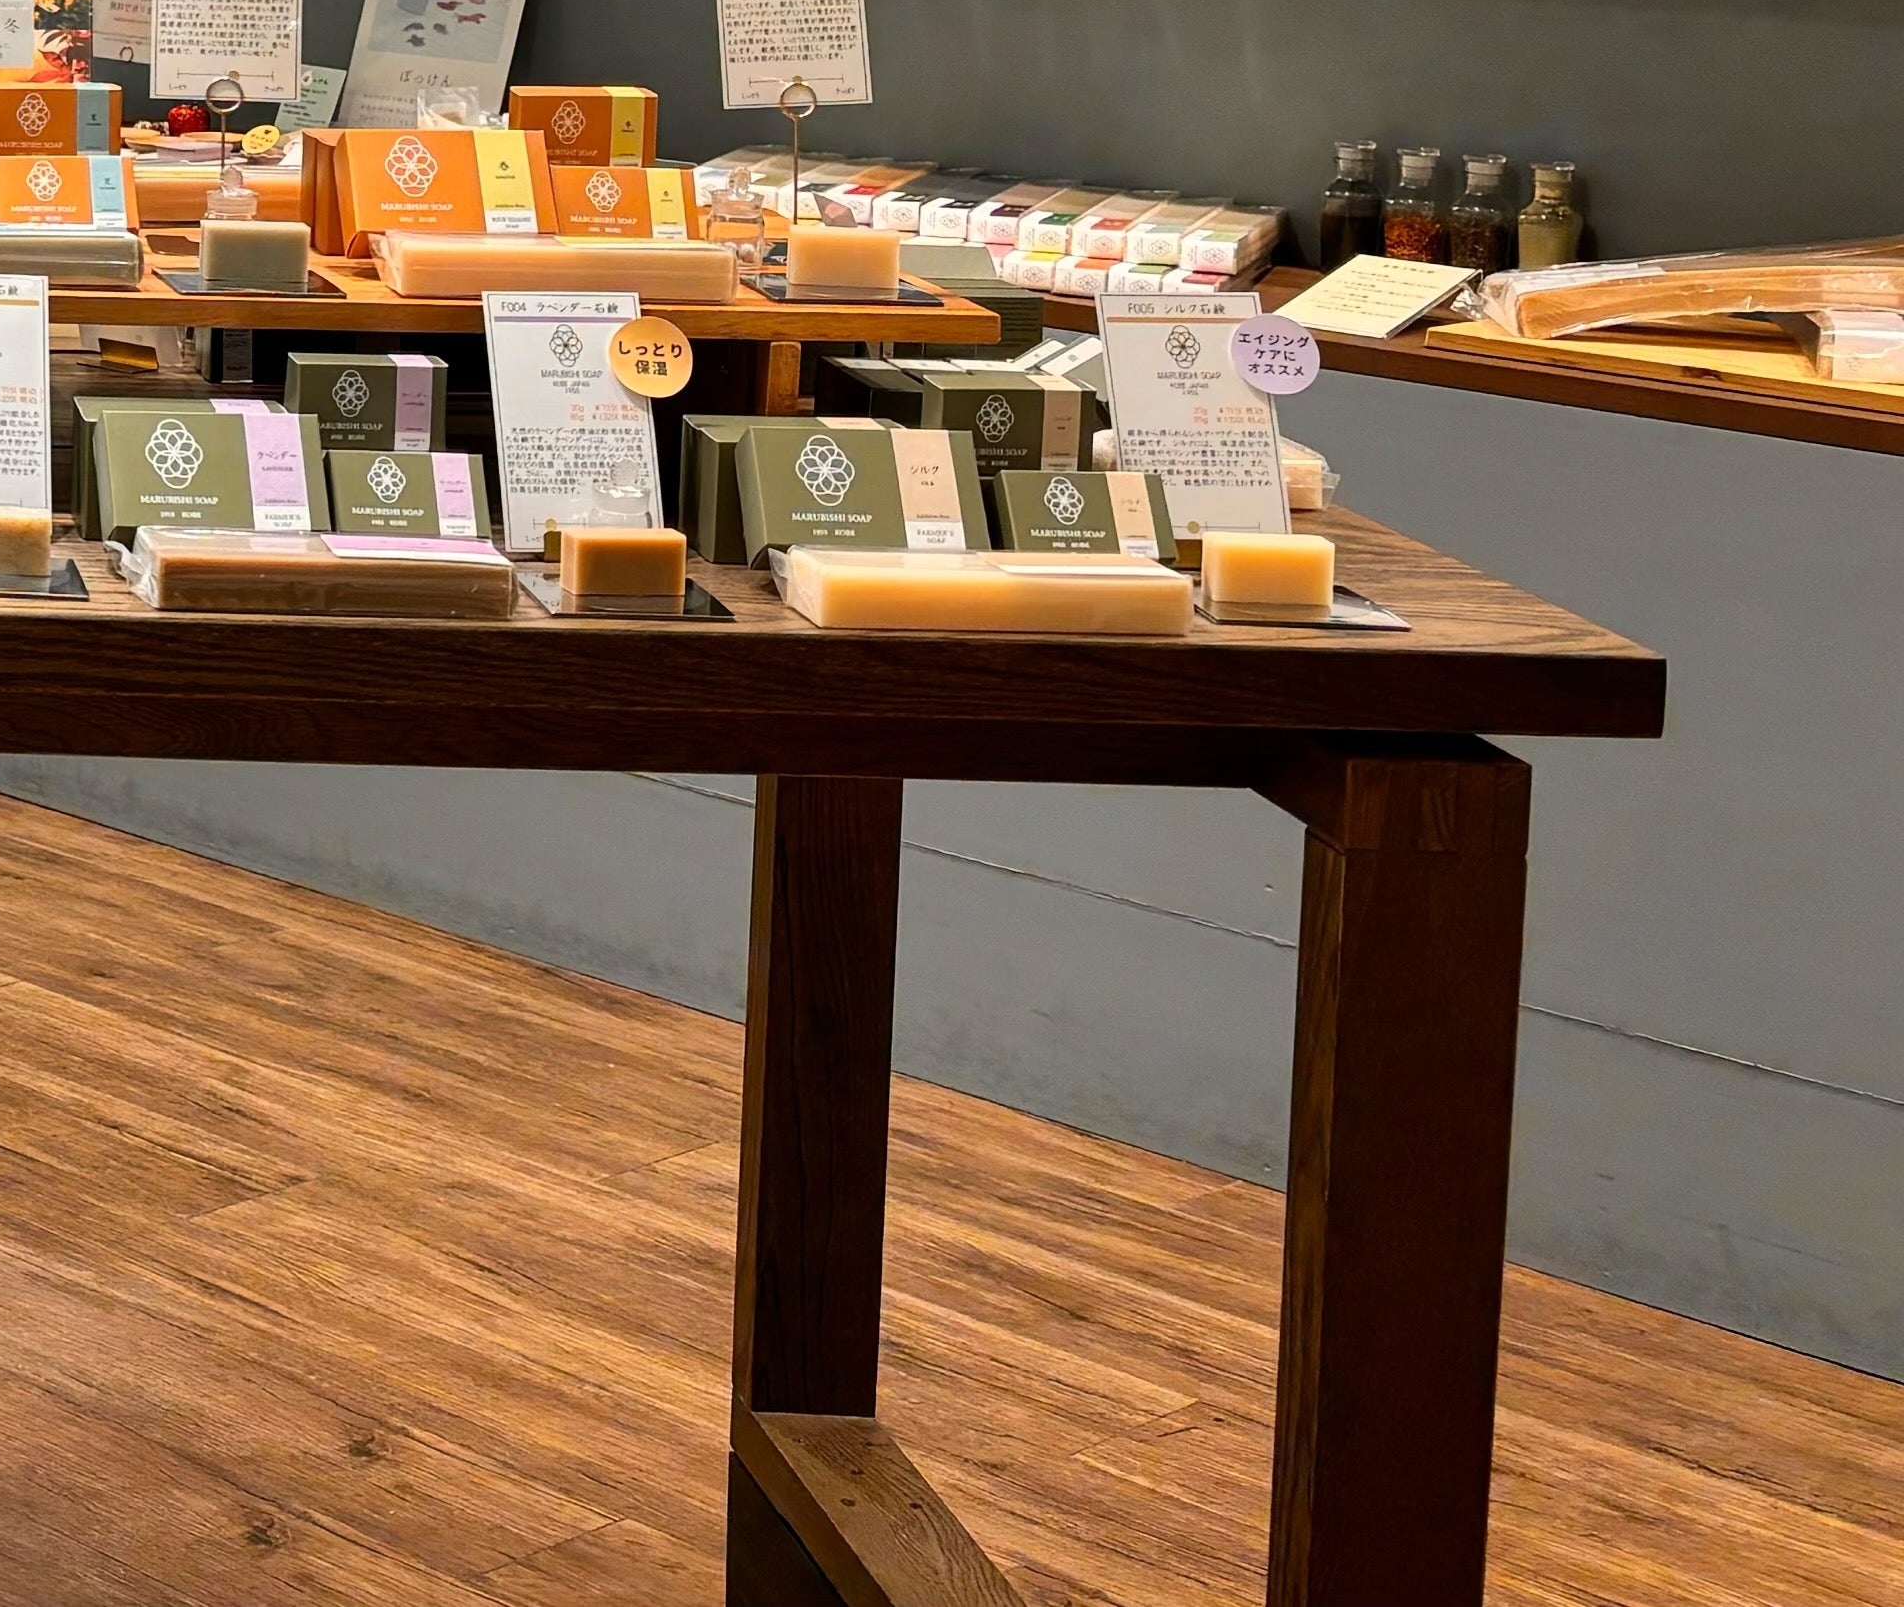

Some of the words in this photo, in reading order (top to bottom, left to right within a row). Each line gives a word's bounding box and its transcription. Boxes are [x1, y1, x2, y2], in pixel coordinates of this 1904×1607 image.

[400, 70, 453, 87] ぼっけん
[431, 203, 454, 212] SOAP
[501, 301, 527, 312] F004
[536, 302, 619, 314] ラベンダー石鹸
[1128, 303, 1155, 314] F005
[1164, 303, 1226, 314] シルク石鹸
[1239, 332, 1309, 348] エイジング
[618, 341, 682, 359] しっとり
[1254, 349, 1296, 361] ケアに
[1248, 363, 1305, 377] オススメ
[909, 464, 940, 476] シルク
[140, 494, 192, 505] MARUBISHI
[194, 495, 218, 506] SOAP
[402, 508, 424, 518] SOAP
[792, 512, 845, 523] MARUBISHI
[847, 513, 873, 523] SOAP
[1031, 528, 1081, 538] MARUBISHI
[1083, 529, 1107, 539] SOAP
